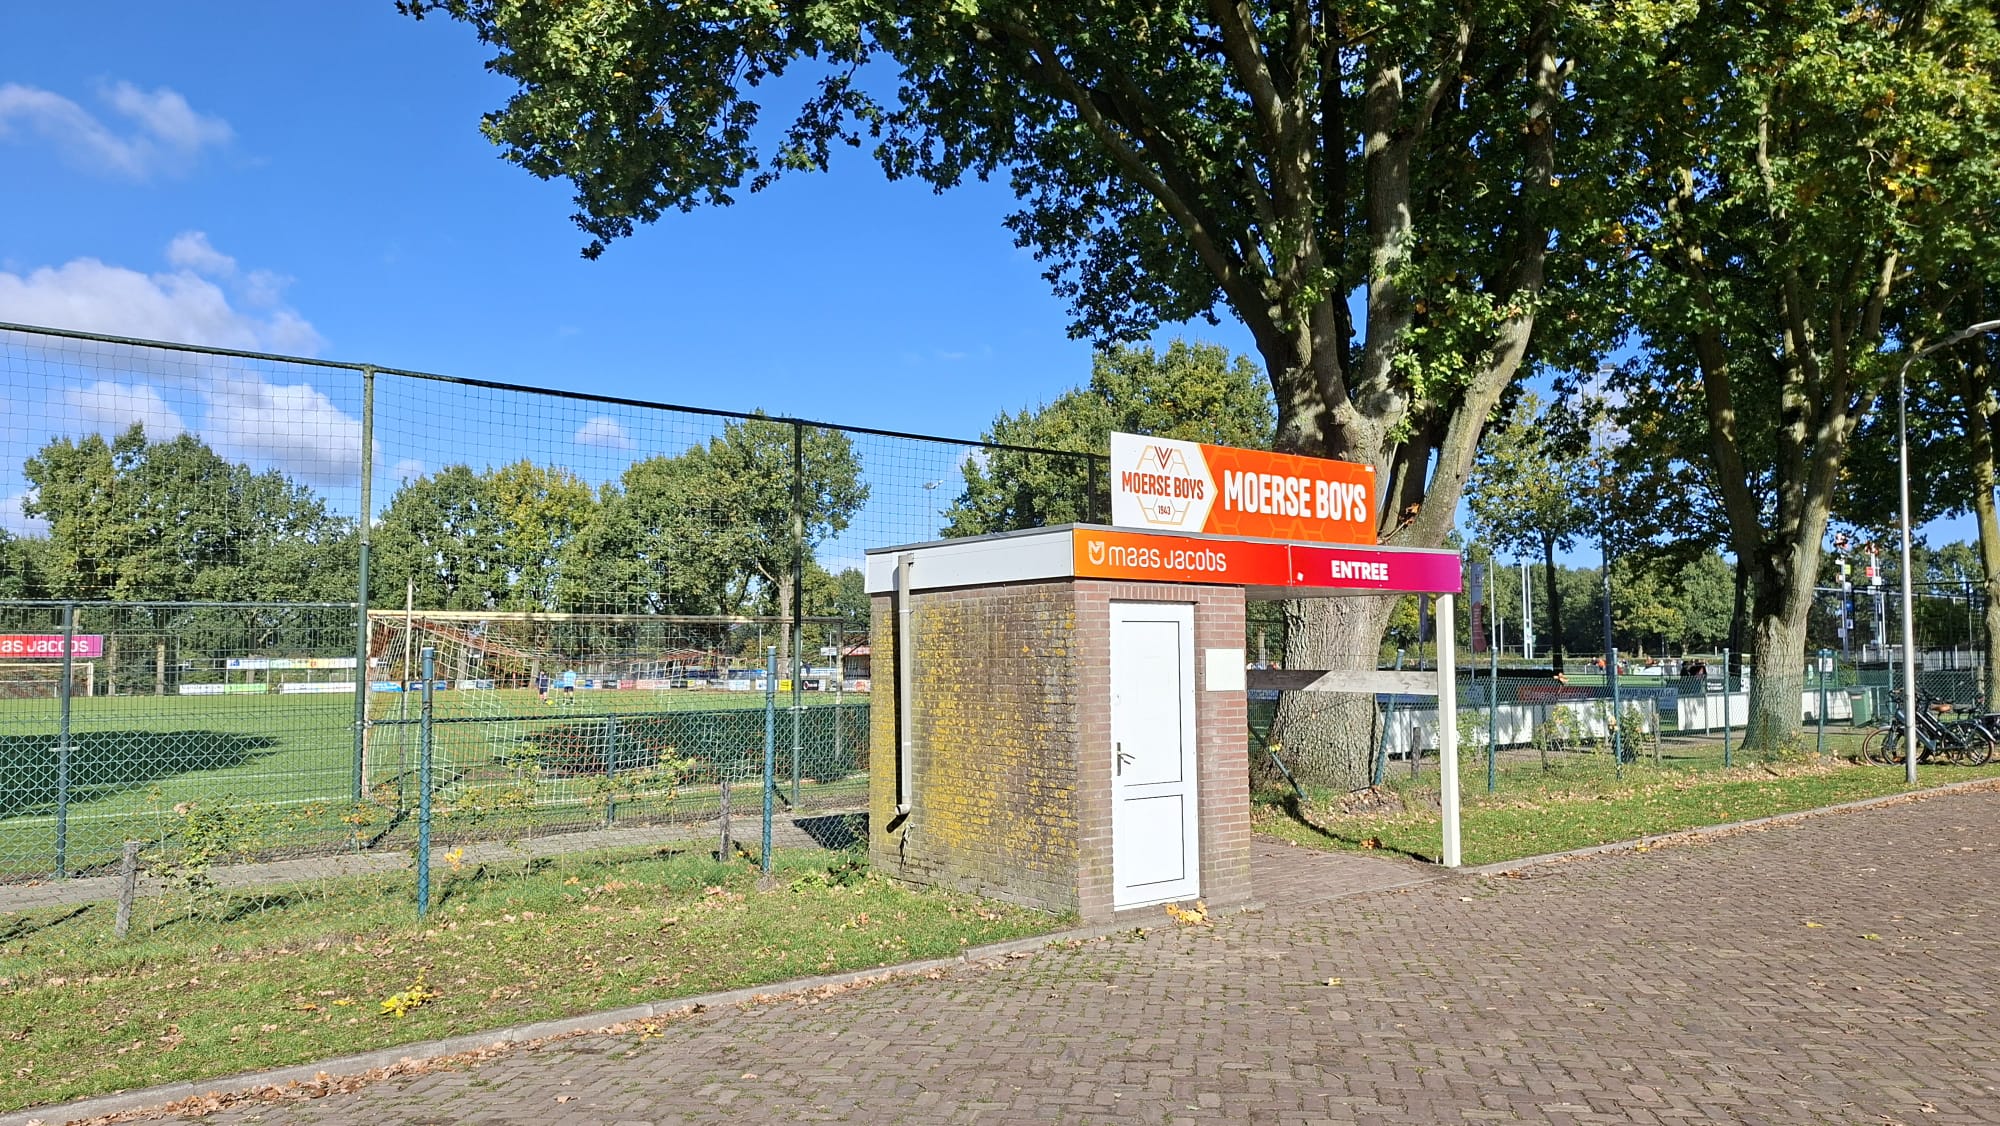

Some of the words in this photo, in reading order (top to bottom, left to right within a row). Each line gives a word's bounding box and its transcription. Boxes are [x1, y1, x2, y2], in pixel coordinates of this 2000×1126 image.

[1122, 471, 1171, 497] MOERSE
[1174, 479, 1204, 500] BOYS
[1224, 469, 1312, 518] MOERSE
[1315, 479, 1367, 523] BOYS
[1158, 505, 1171, 515] 1943
[1108, 546, 1161, 568] maas
[1331, 559, 1389, 581] ENTREE
